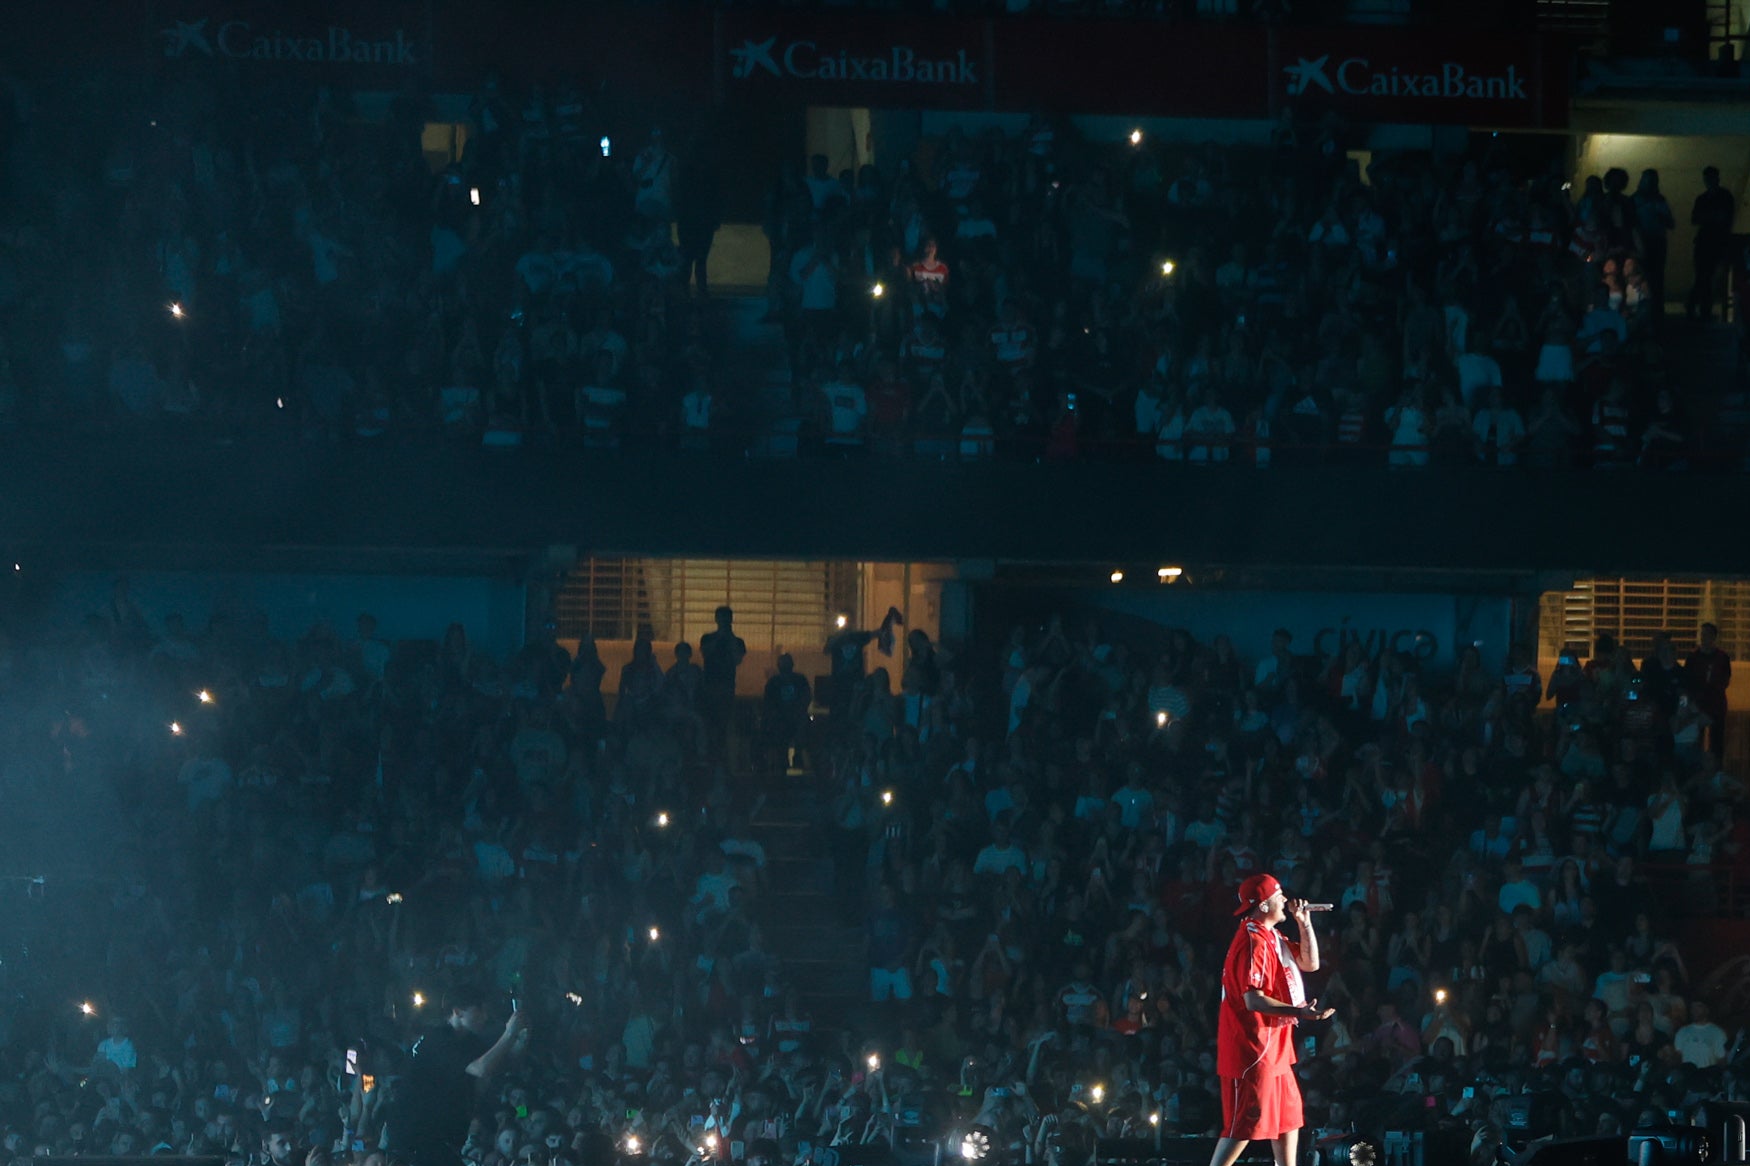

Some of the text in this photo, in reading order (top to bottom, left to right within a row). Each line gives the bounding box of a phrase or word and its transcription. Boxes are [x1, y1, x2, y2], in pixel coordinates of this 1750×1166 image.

[217, 20, 416, 65] CaixaBank
[783, 40, 978, 83] CaixaBank
[1336, 58, 1528, 100] CaixaBank
